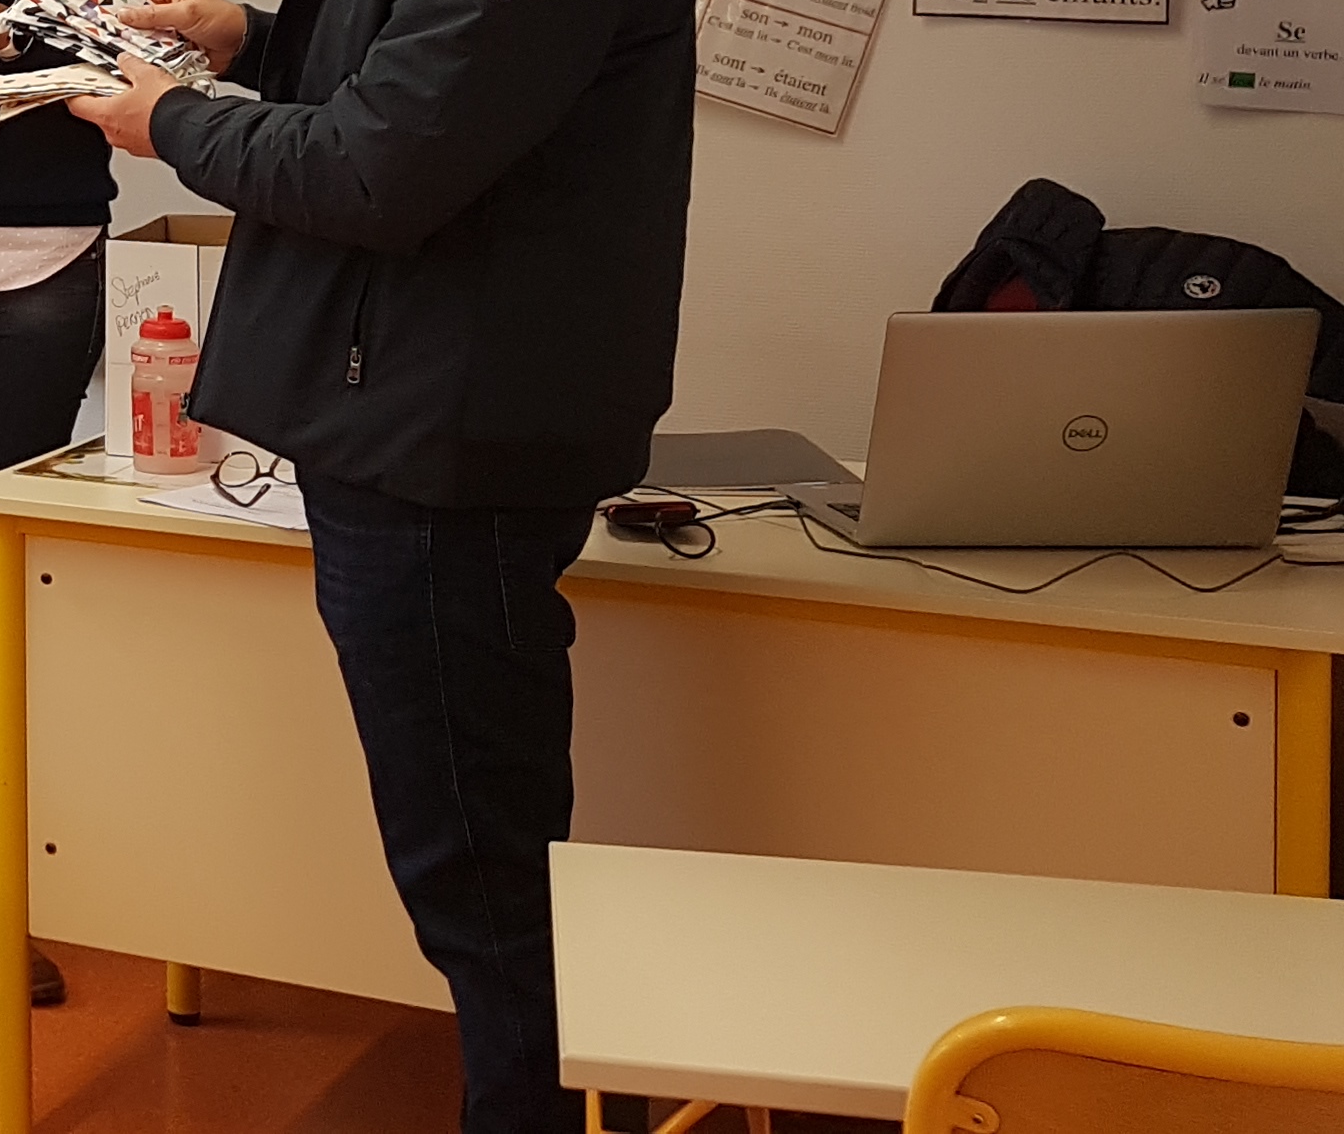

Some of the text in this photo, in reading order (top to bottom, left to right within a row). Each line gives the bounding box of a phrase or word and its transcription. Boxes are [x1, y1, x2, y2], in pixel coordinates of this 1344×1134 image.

[740, 8, 834, 45] son mon
[1276, 20, 1307, 41] Se
[1236, 43, 1300, 59] devant un
[712, 53, 829, 97] sont étaient
[1068, 428, 1102, 439] DELL
